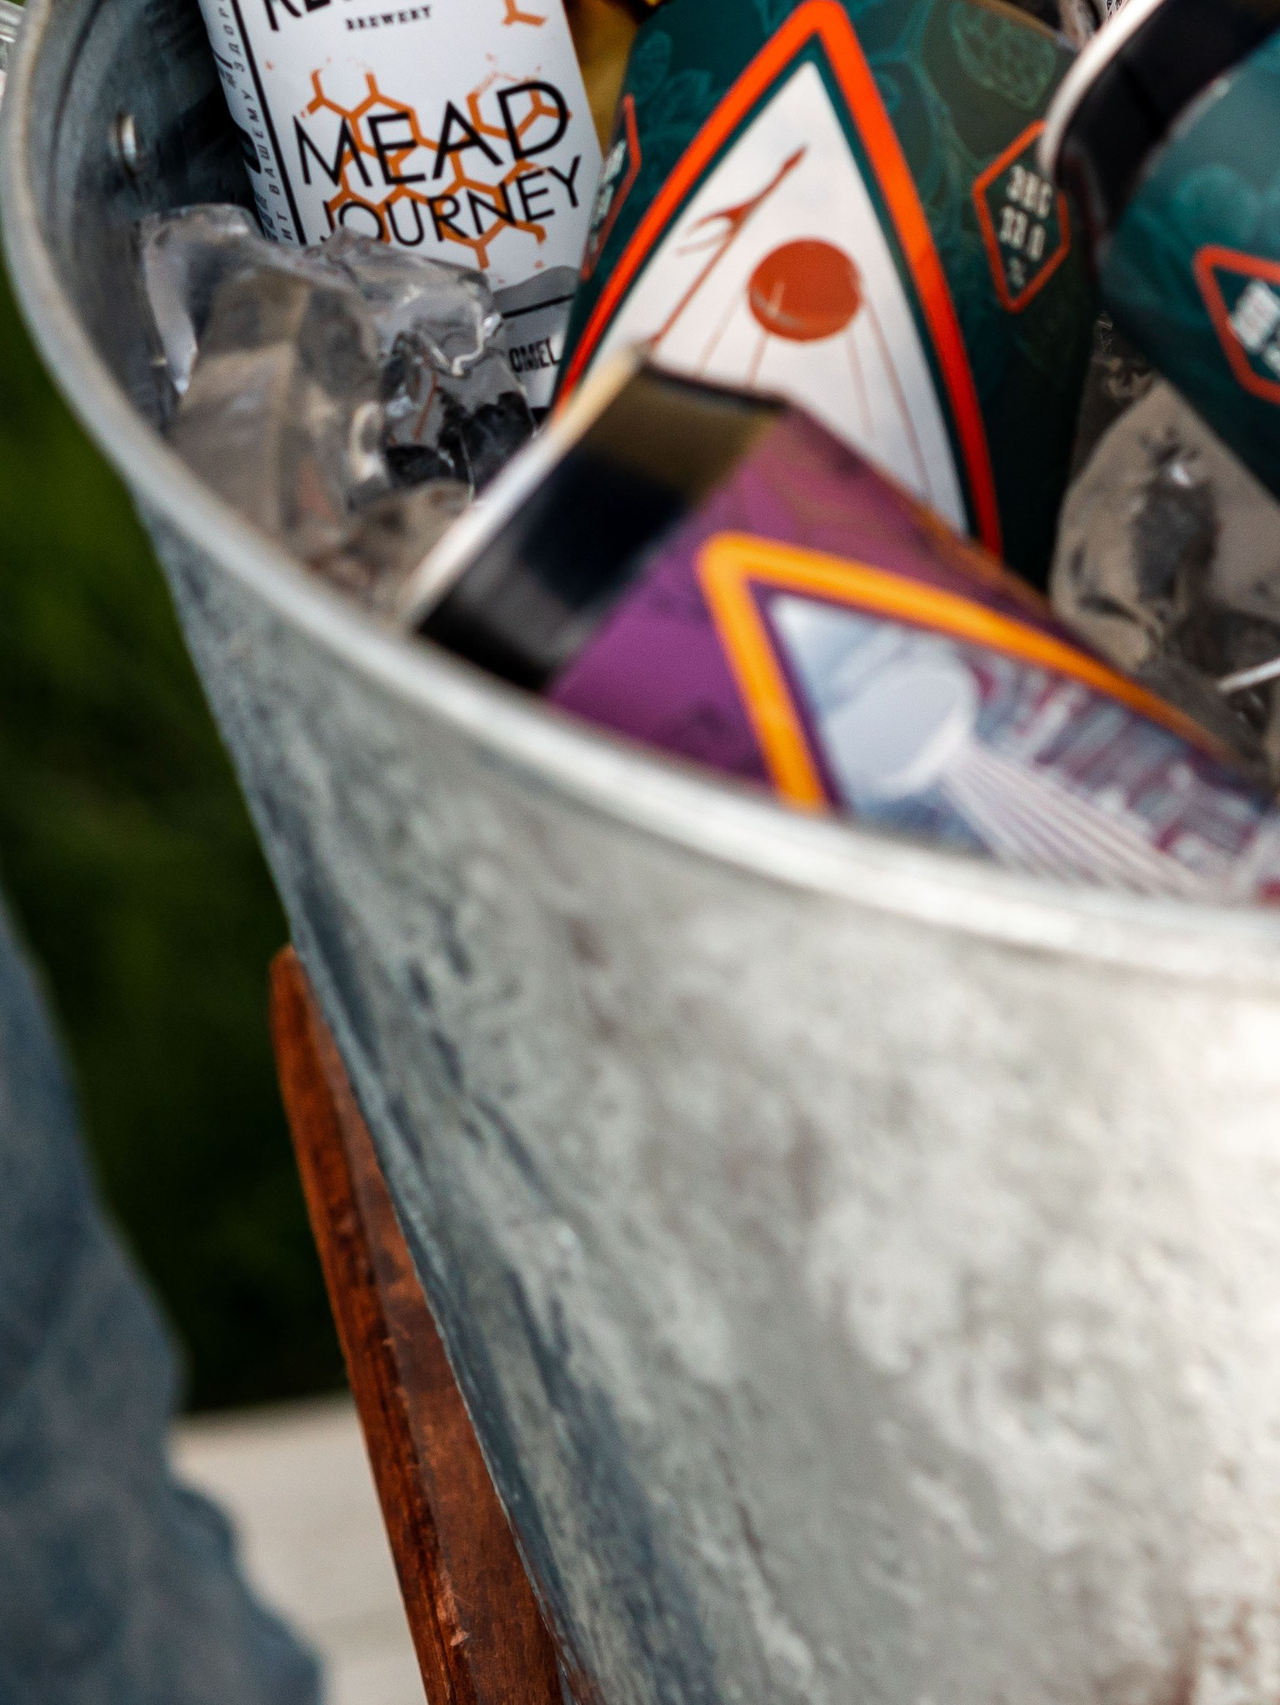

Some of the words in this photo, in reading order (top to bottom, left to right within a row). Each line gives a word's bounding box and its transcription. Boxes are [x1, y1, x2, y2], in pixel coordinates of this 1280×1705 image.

[345, 5, 432, 31] BREWERY
[293, 81, 568, 188] MEAD
[319, 155, 582, 247] JOURNEY
[508, 336, 561, 373] OMEL
